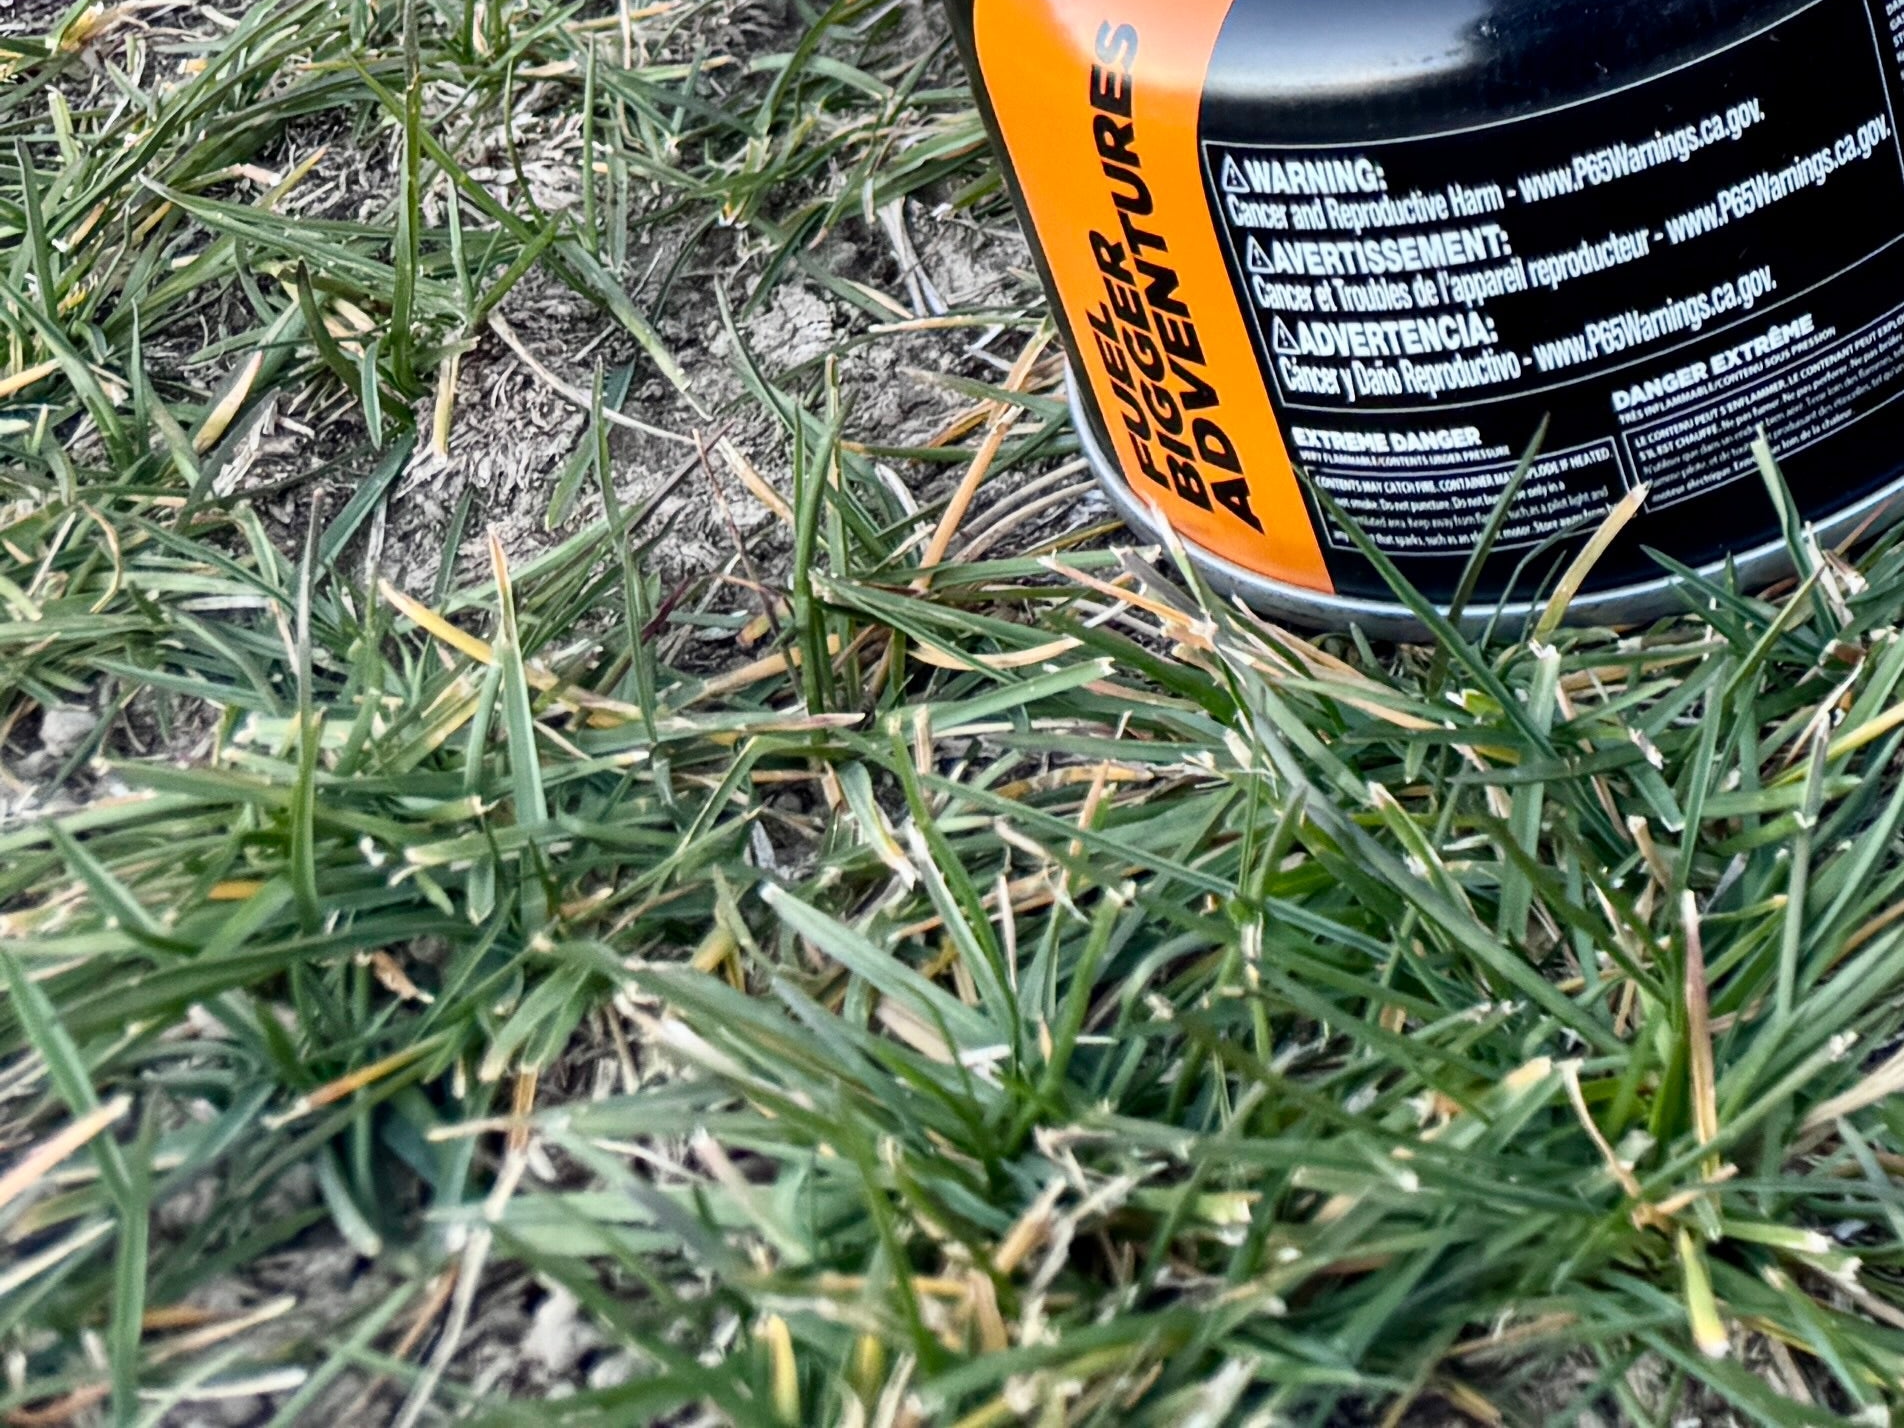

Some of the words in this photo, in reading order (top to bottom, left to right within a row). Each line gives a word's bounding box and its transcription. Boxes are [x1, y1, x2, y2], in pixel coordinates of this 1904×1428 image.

[1226, 194, 1288, 229] Cancer
[1290, 194, 1327, 231] and
[1327, 188, 1450, 235] Reproductive
[1449, 180, 1505, 217] Harm
[1517, 96, 1767, 204] www.P65Warnings.ca.gov.
[1243, 157, 1388, 194] WARNING:
[1252, 275, 1312, 311] Cancer
[1312, 278, 1336, 312] et
[1335, 274, 1412, 312] Troubles
[1412, 272, 1439, 306] de
[1439, 258, 1529, 309] l'appareil
[1527, 228, 1652, 292] reproducteur
[1664, 112, 1892, 245] www.P65Warnings.ca.gov.
[1089, 20, 1265, 535] ADVENTURES
[1270, 223, 1513, 276] AVERTISSEMENT:
[1084, 300, 1171, 490] FUEL
[1087, 230, 1214, 512] BIGGER
[1297, 310, 1499, 357] ADVERTENCIA:
[1339, 370, 1356, 403] y
[1403, 346, 1521, 400] Reproductivo
[1533, 263, 1778, 373] www.P65Warnings.ca.gov.
[1612, 361, 1709, 411] DANGER
[1709, 313, 1815, 377] EXTRÊME
[1291, 426, 1390, 453] EXTREME
[1389, 426, 1482, 453] DANGER
